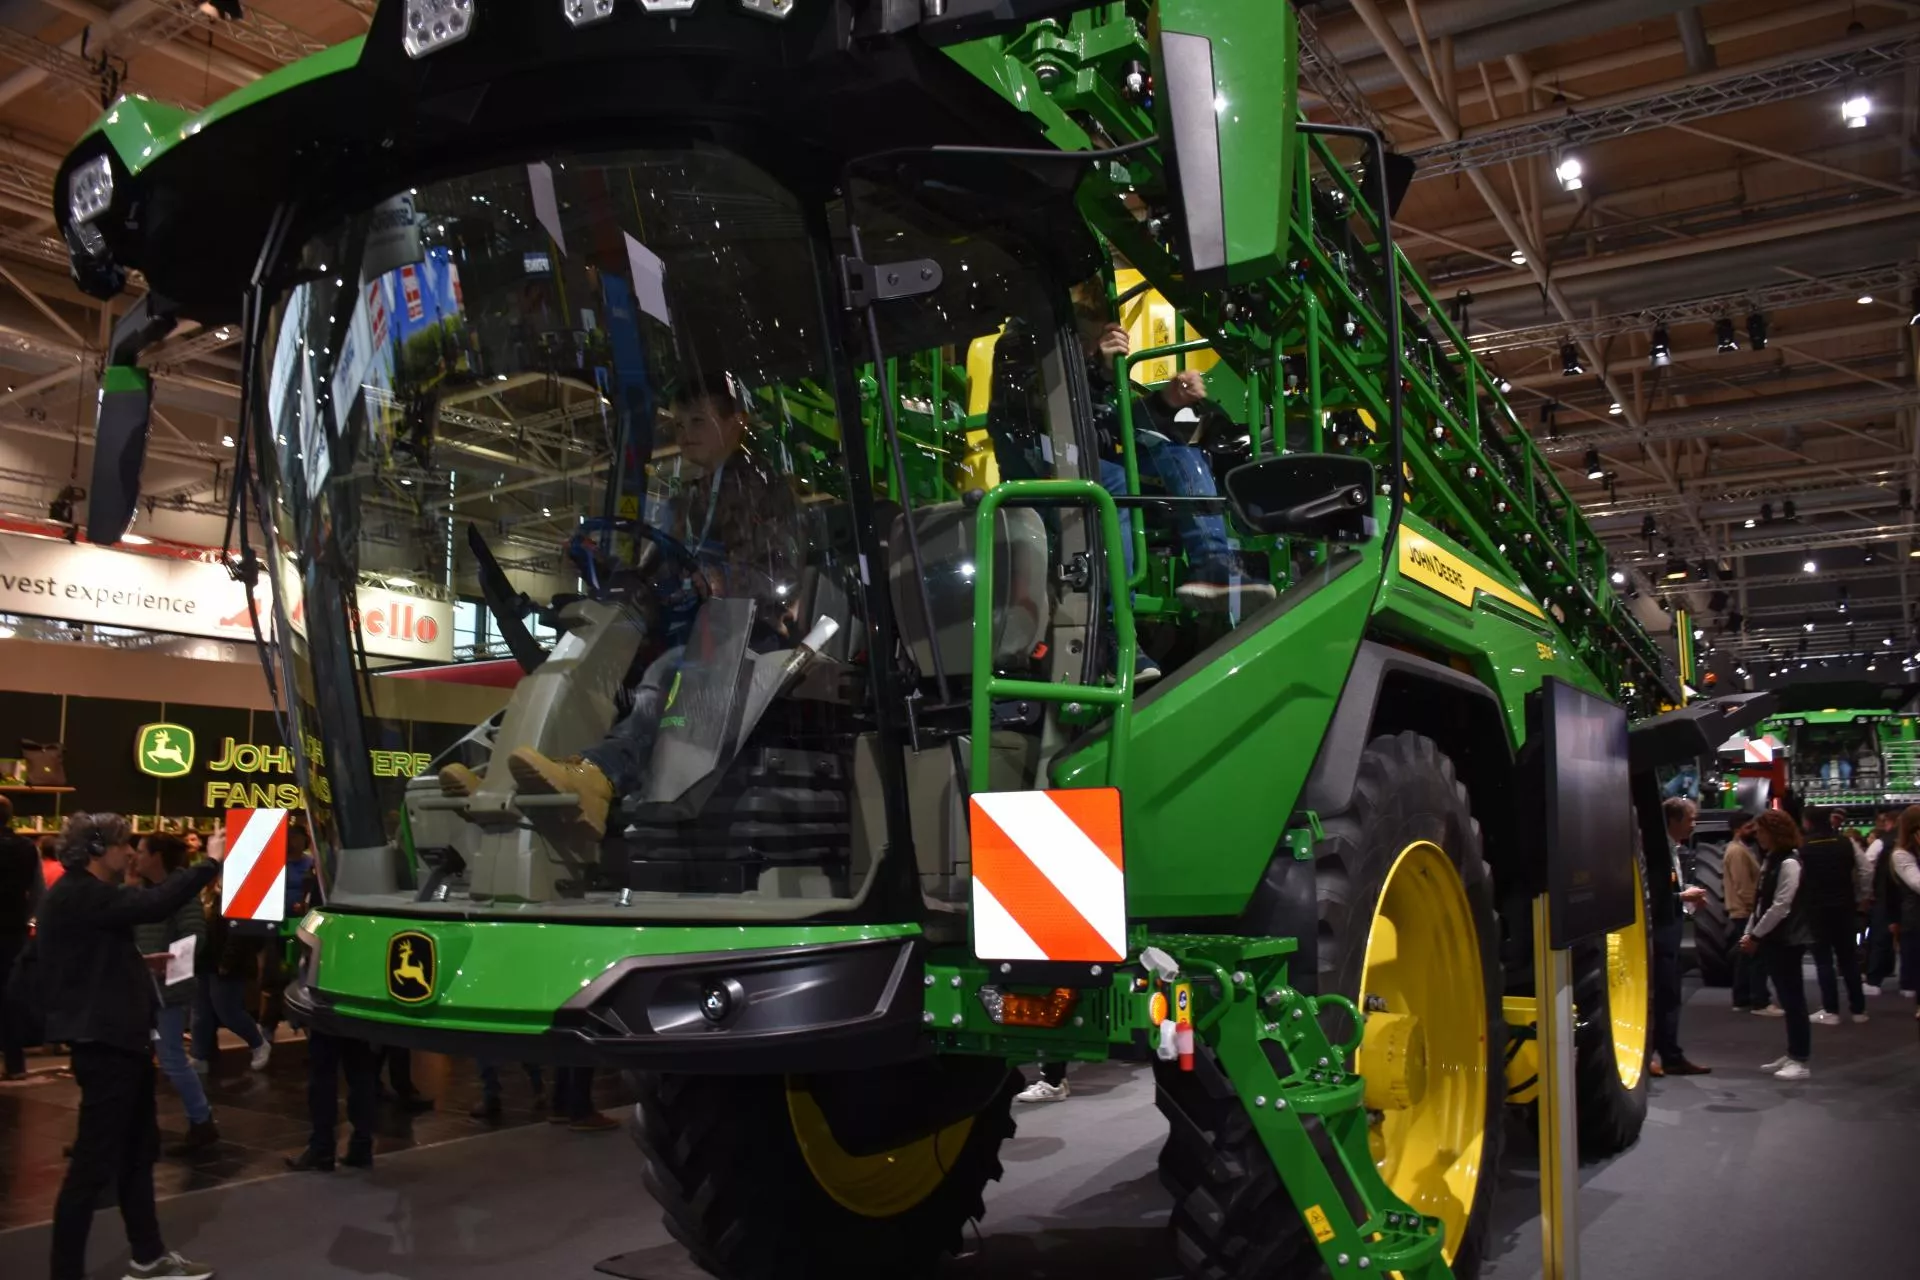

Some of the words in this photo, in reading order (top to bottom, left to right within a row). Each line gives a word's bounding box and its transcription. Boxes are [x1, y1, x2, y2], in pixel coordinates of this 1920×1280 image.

[1408, 542, 1436, 575] JOHN
[1433, 555, 1466, 591] DEERE
[0, 574, 57, 597] vest
[64, 583, 197, 615] experience
[369, 749, 432, 777] ERE
